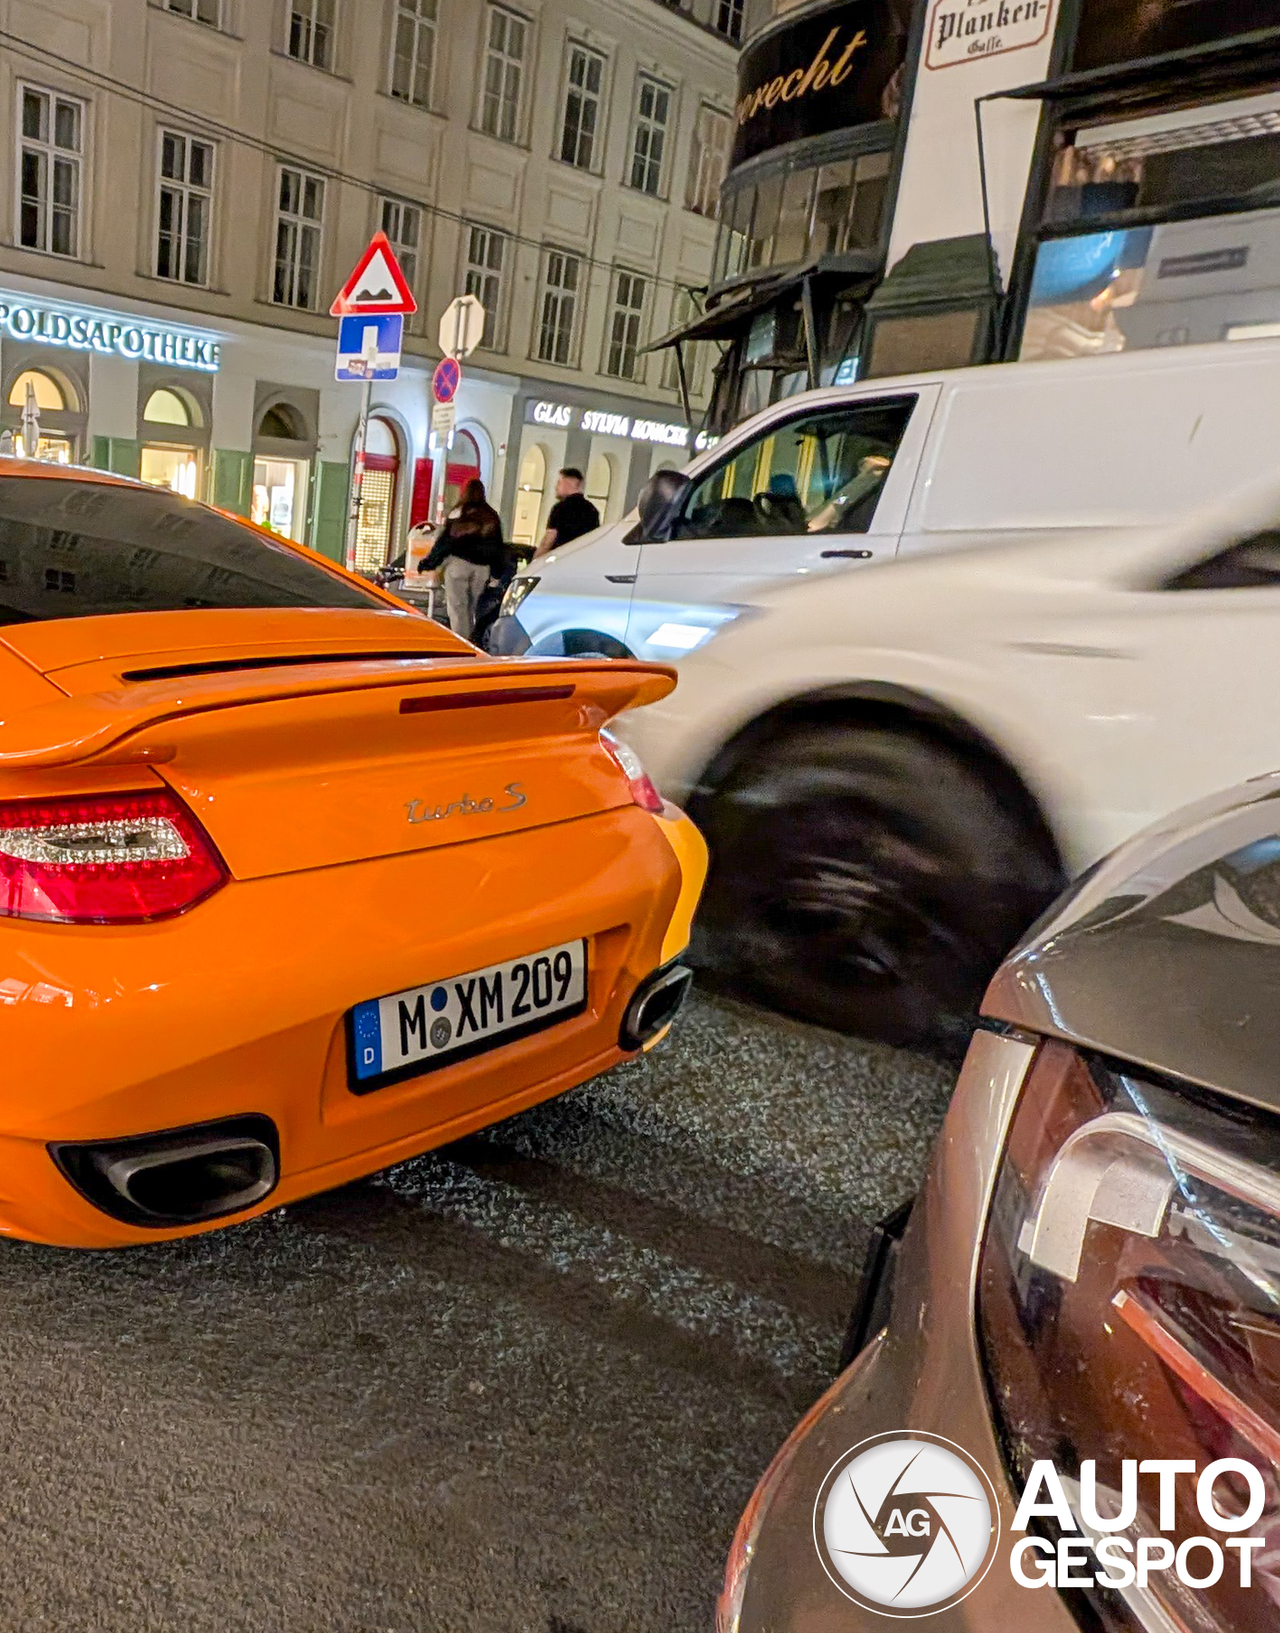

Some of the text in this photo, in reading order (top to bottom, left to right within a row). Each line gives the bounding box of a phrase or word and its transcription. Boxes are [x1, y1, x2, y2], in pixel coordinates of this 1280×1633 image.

[936, 0, 1046, 49] Planken-
[534, 401, 571, 426] GLAS
[581, 410, 629, 437] SYLVIA
[404, 782, 527, 824] turbo S
[398, 951, 572, 1056] M XM 209
[364, 1047, 375, 1065] D
